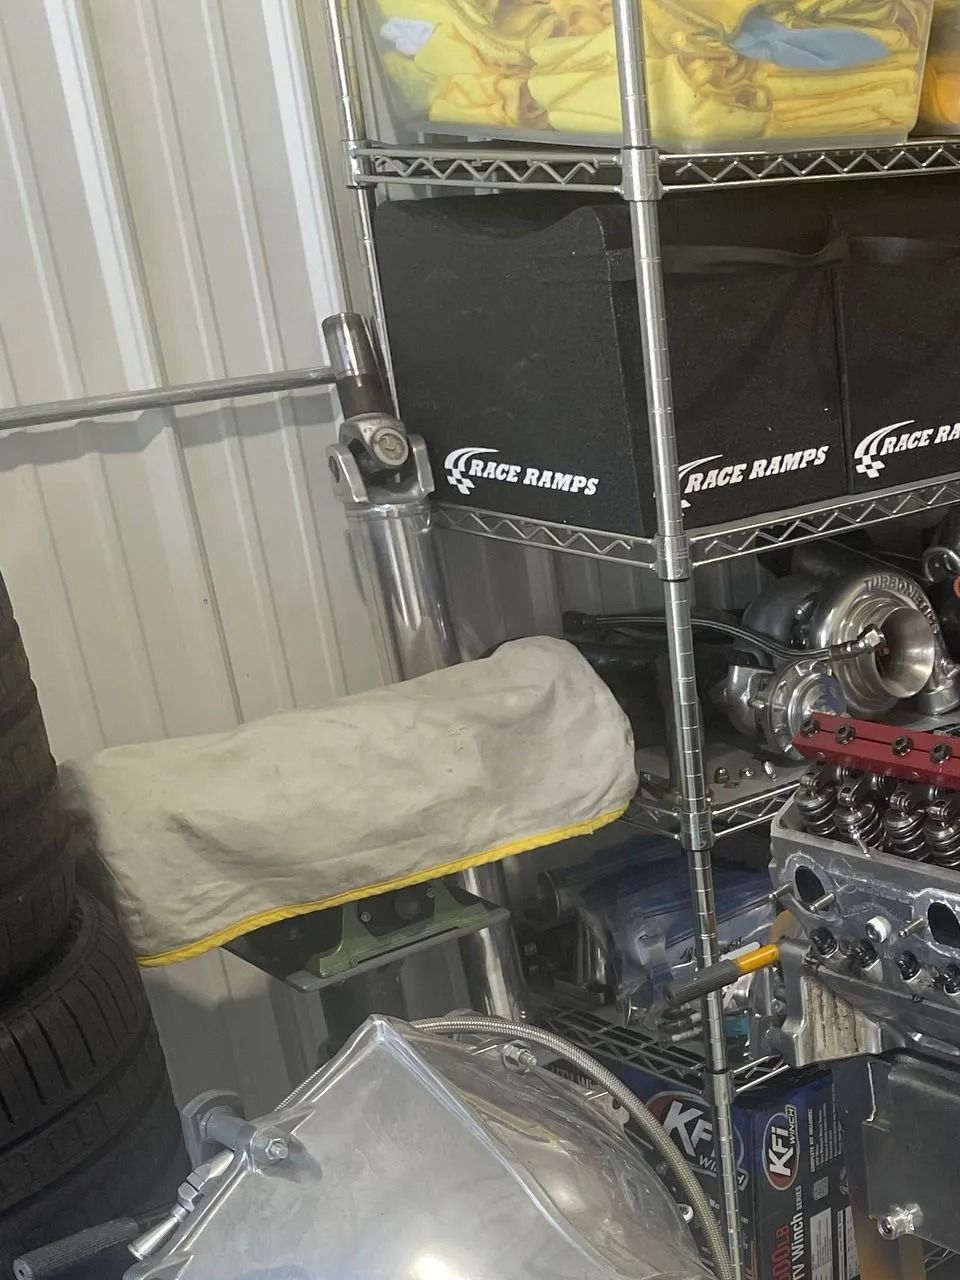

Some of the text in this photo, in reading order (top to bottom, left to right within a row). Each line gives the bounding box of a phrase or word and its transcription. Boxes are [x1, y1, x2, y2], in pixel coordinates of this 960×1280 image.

[880, 428, 934, 456] RACE
[468, 458, 600, 496] RACE RAMPS
[684, 445, 830, 494] RACE RAMPS
[662, 1099, 715, 1157] KF
[787, 1108, 796, 1145] WINCH
[790, 1212, 805, 1262] Winch
